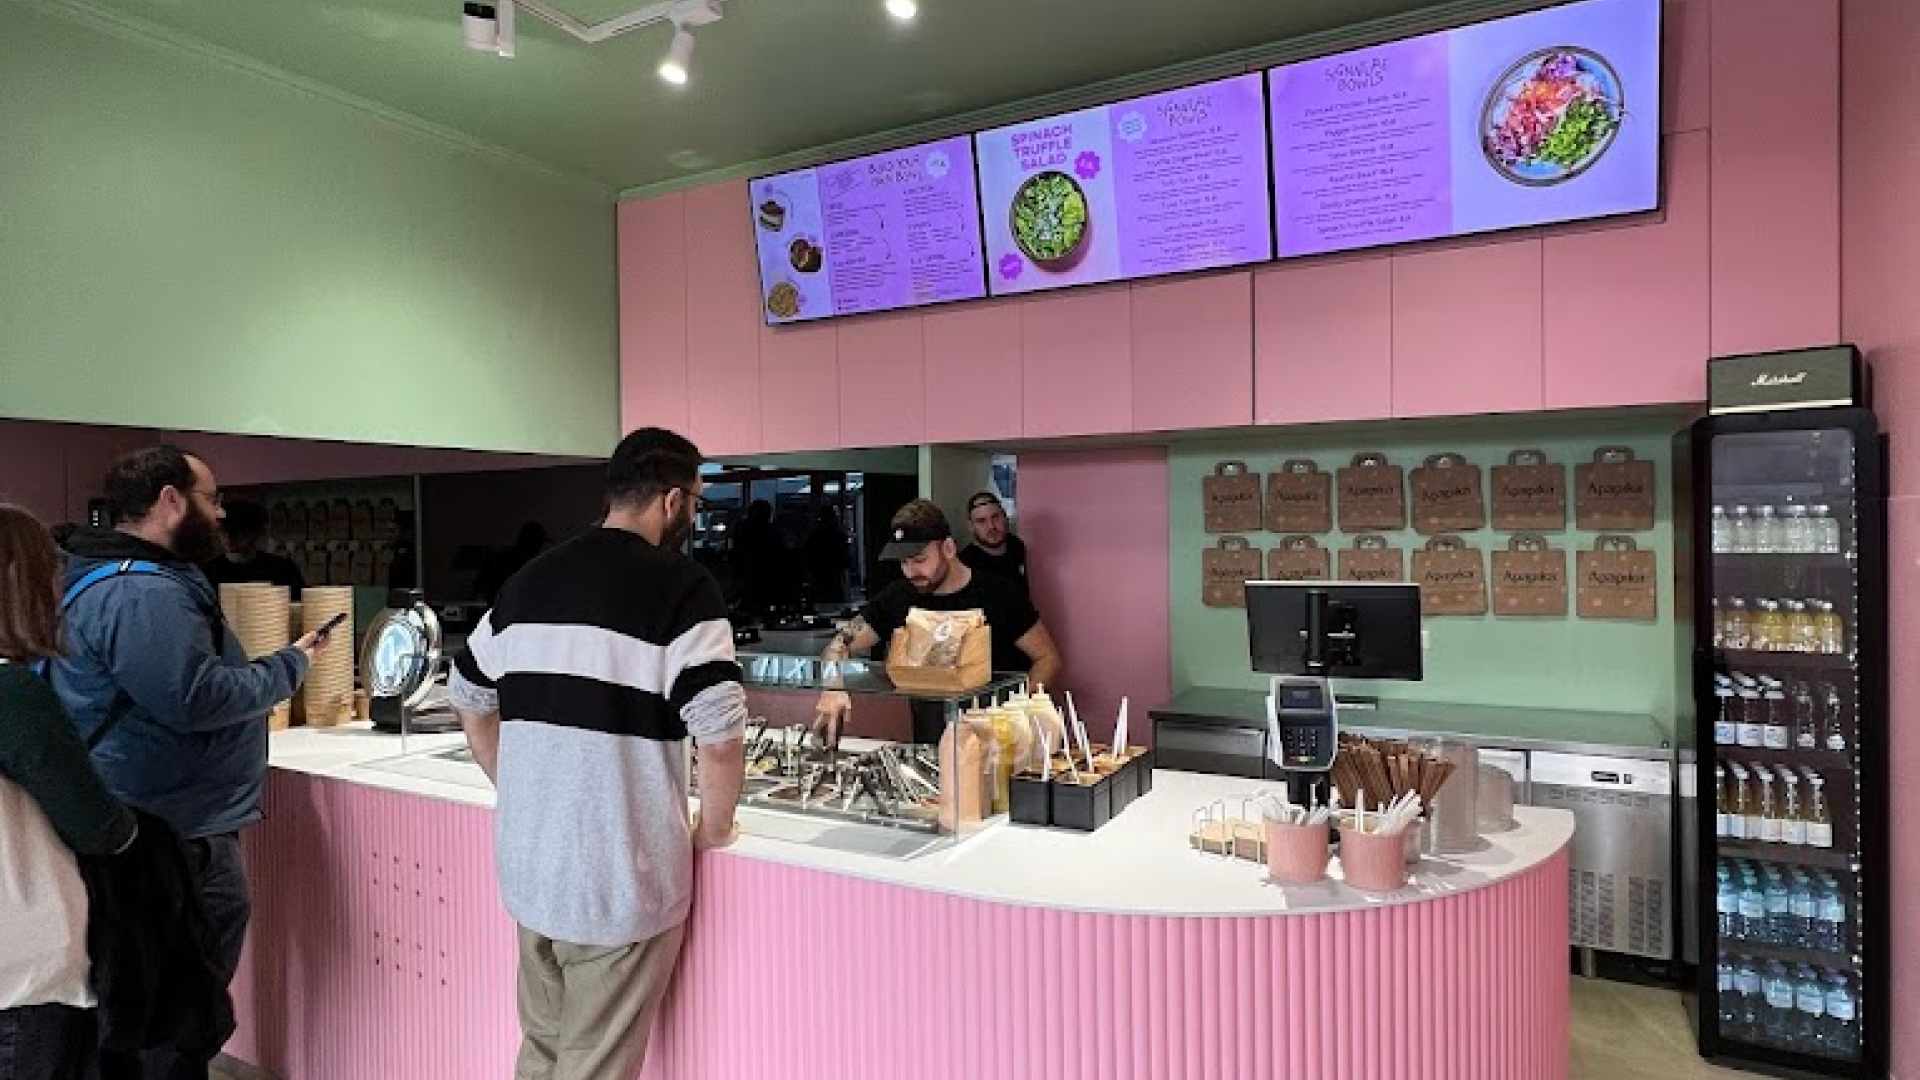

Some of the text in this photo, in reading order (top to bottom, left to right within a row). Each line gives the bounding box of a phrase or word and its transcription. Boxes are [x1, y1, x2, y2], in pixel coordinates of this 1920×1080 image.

[1011, 123, 1073, 147] SPINACH
[1013, 136, 1073, 159] TRUFFLE
[1021, 151, 1067, 171] SALAD
